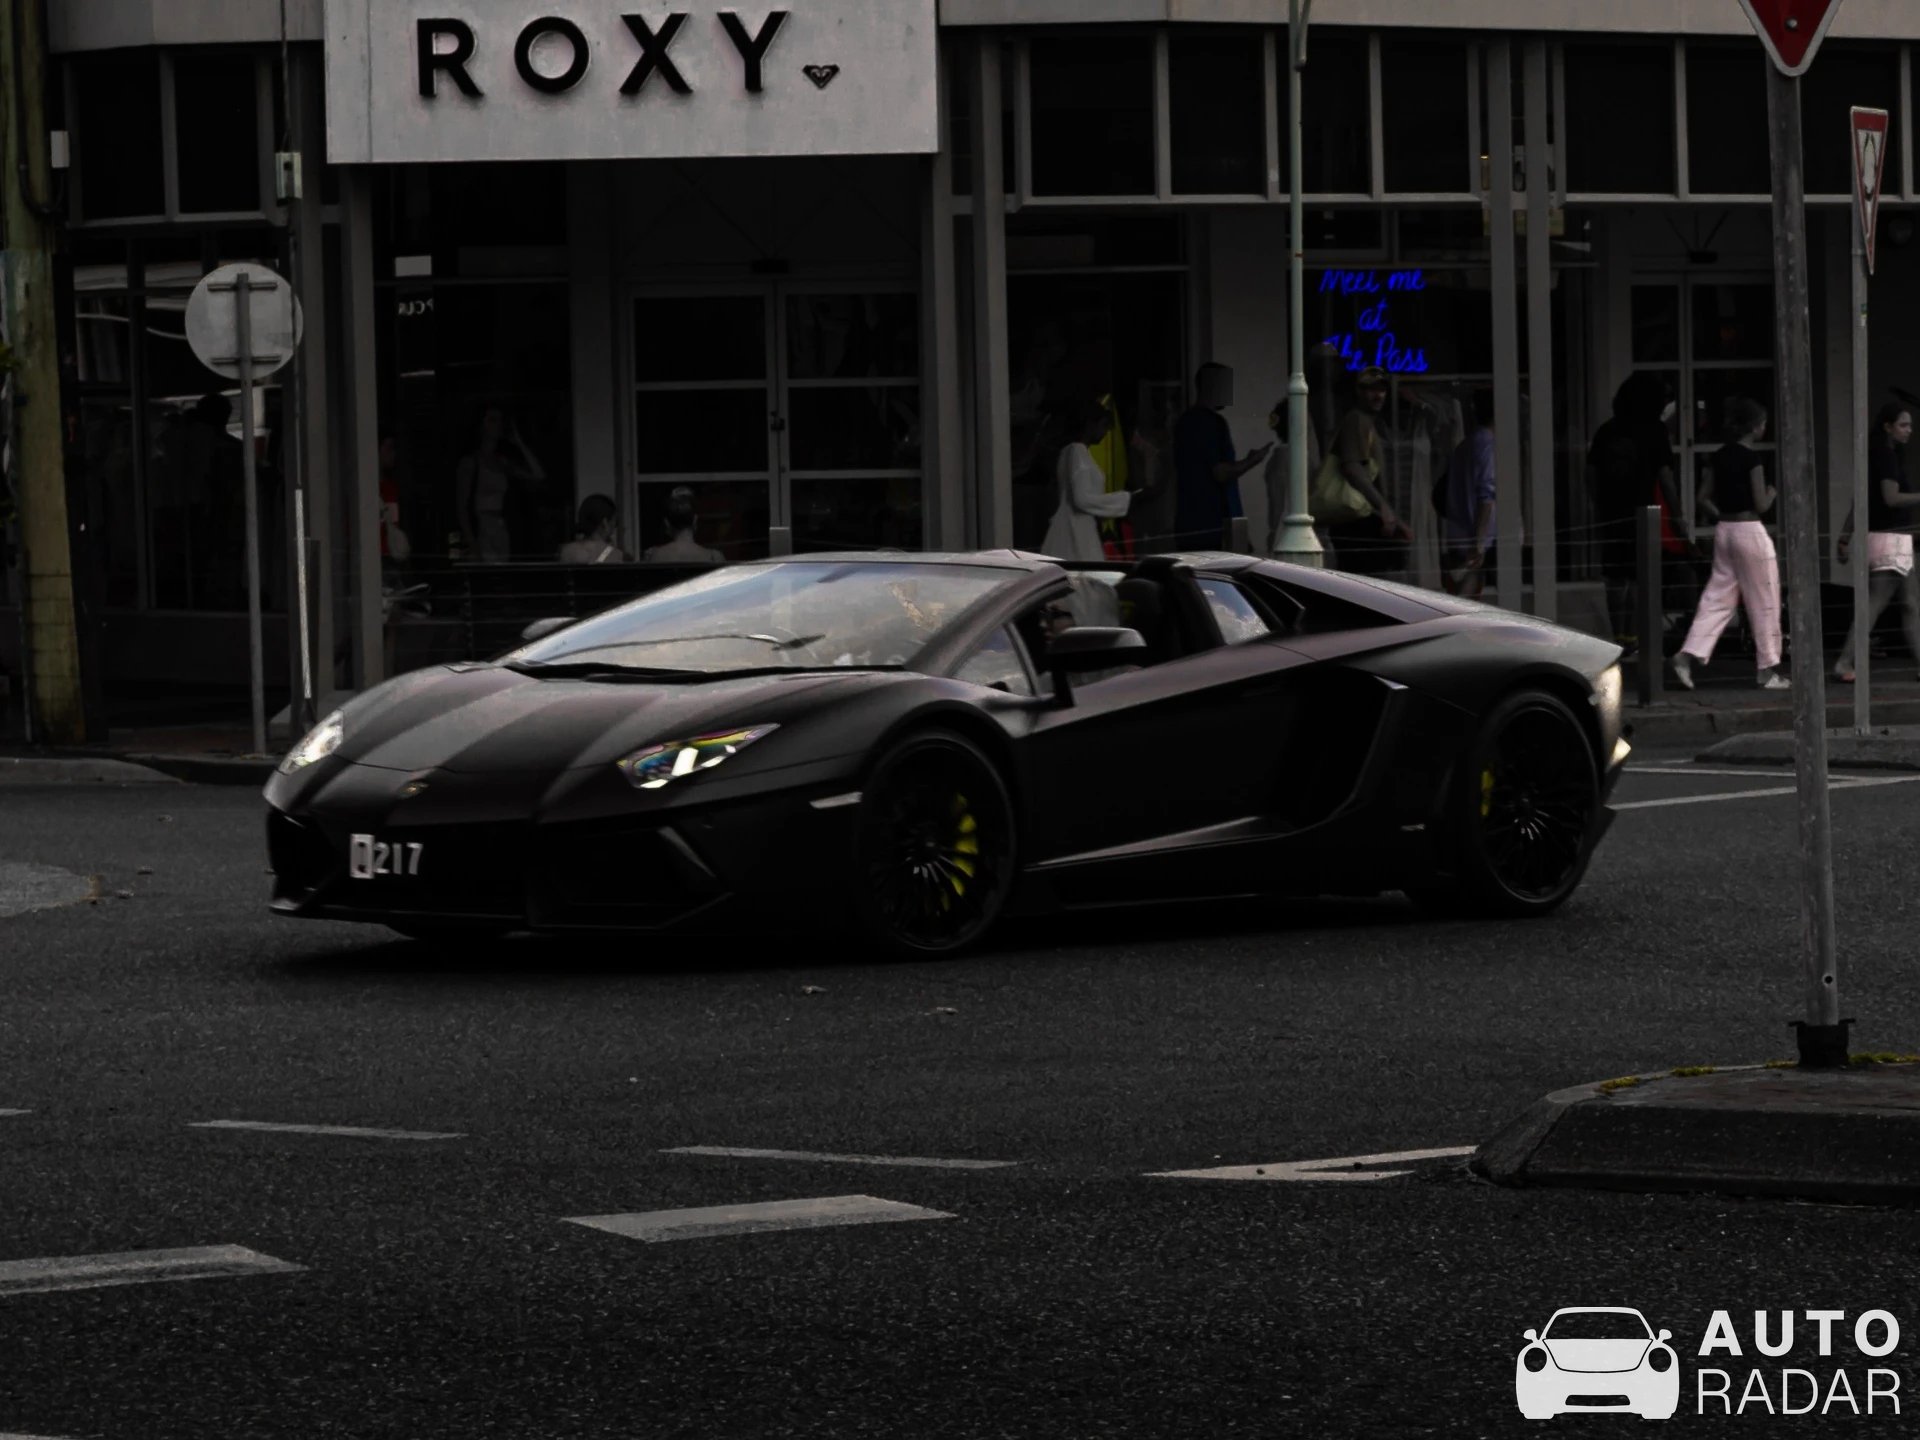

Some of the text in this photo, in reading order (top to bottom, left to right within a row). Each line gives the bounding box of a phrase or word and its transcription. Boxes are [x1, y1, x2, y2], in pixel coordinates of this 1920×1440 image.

[417, 11, 788, 97] ROXY
[1319, 269, 1427, 296] Meet me
[1358, 296, 1390, 332] at
[1374, 330, 1429, 373] Pass
